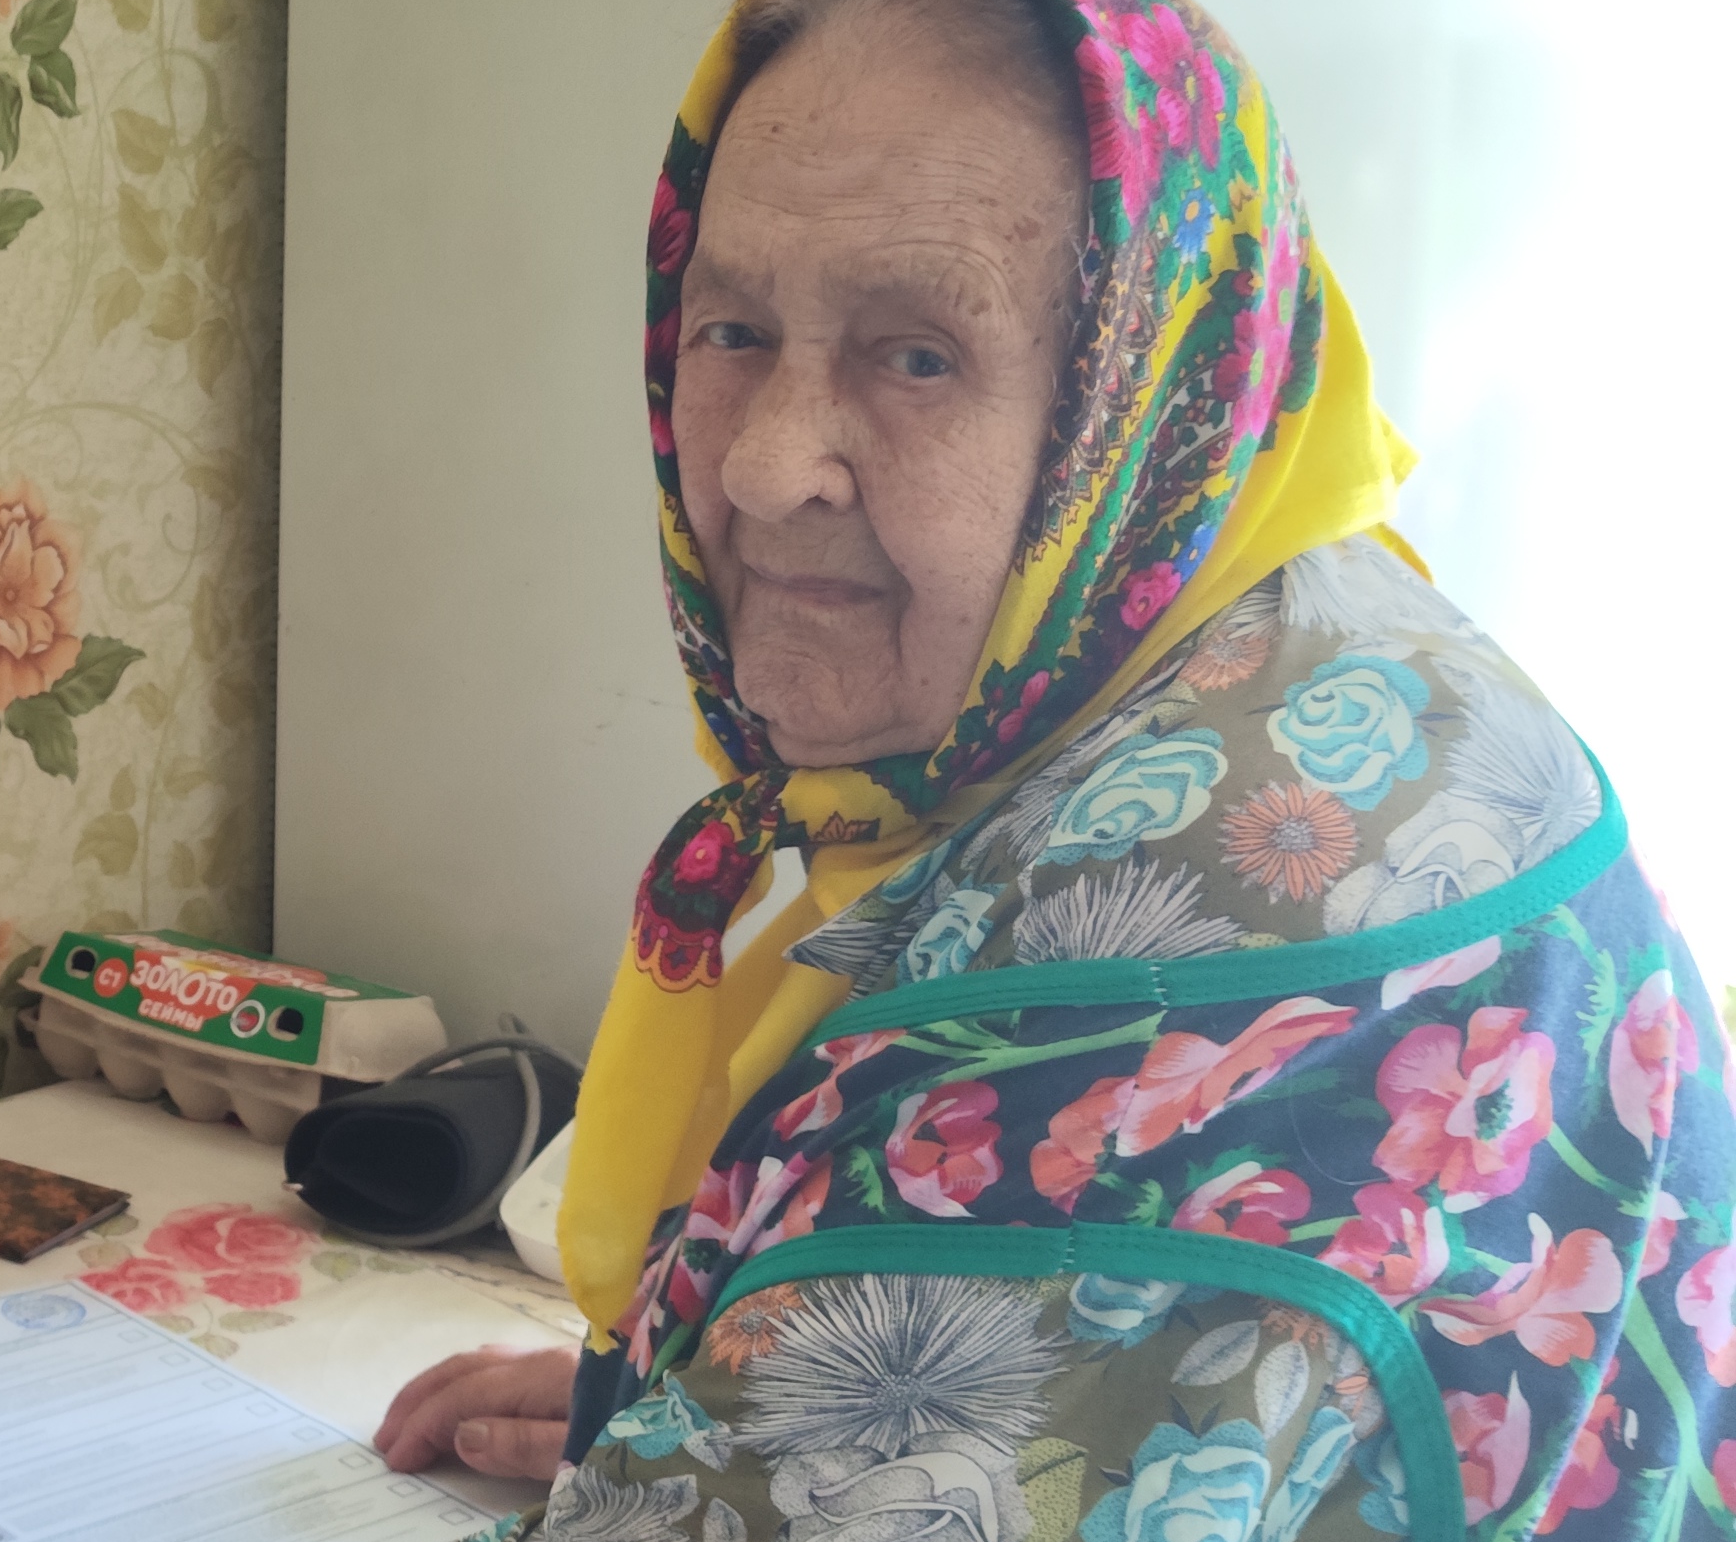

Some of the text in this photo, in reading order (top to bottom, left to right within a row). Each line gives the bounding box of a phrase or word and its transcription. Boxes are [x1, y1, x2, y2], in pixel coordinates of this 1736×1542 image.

[99, 968, 121, 988] С1
[129, 961, 238, 1012] ЗОЛОТО
[138, 998, 204, 1030] СЕЙМЫ
